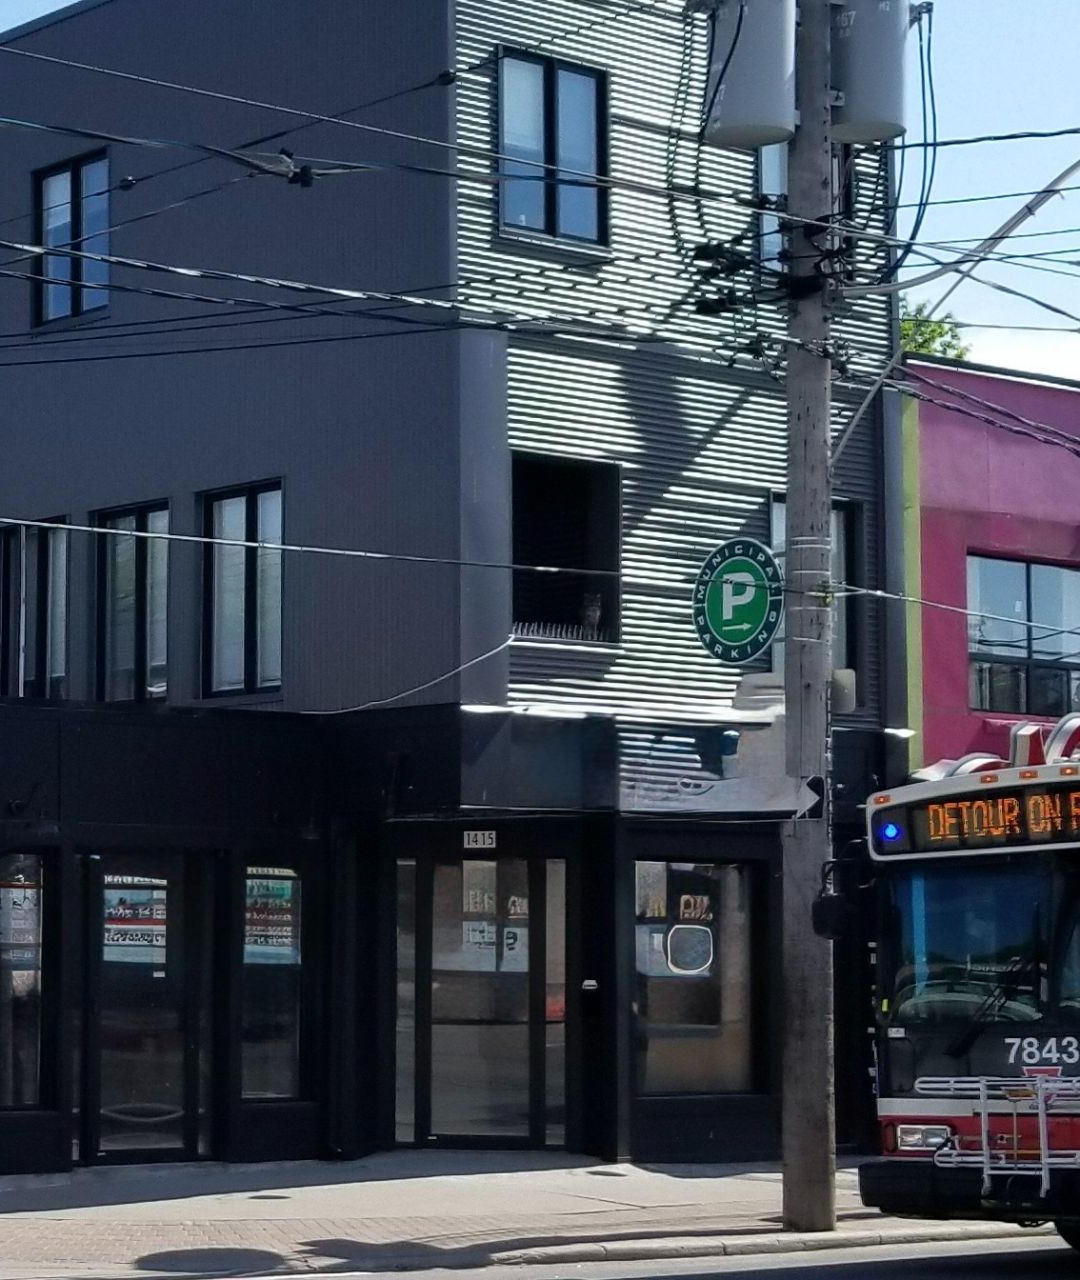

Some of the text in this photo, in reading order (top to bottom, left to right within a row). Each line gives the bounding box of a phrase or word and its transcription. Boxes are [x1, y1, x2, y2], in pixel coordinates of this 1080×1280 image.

[722, 571, 756, 620] P
[697, 610, 778, 659] PARKING
[465, 832, 494, 846] 1415
[927, 797, 1020, 840] DETOUR
[1028, 793, 1062, 833] ON
[1004, 1036, 1080, 1064] 7843
